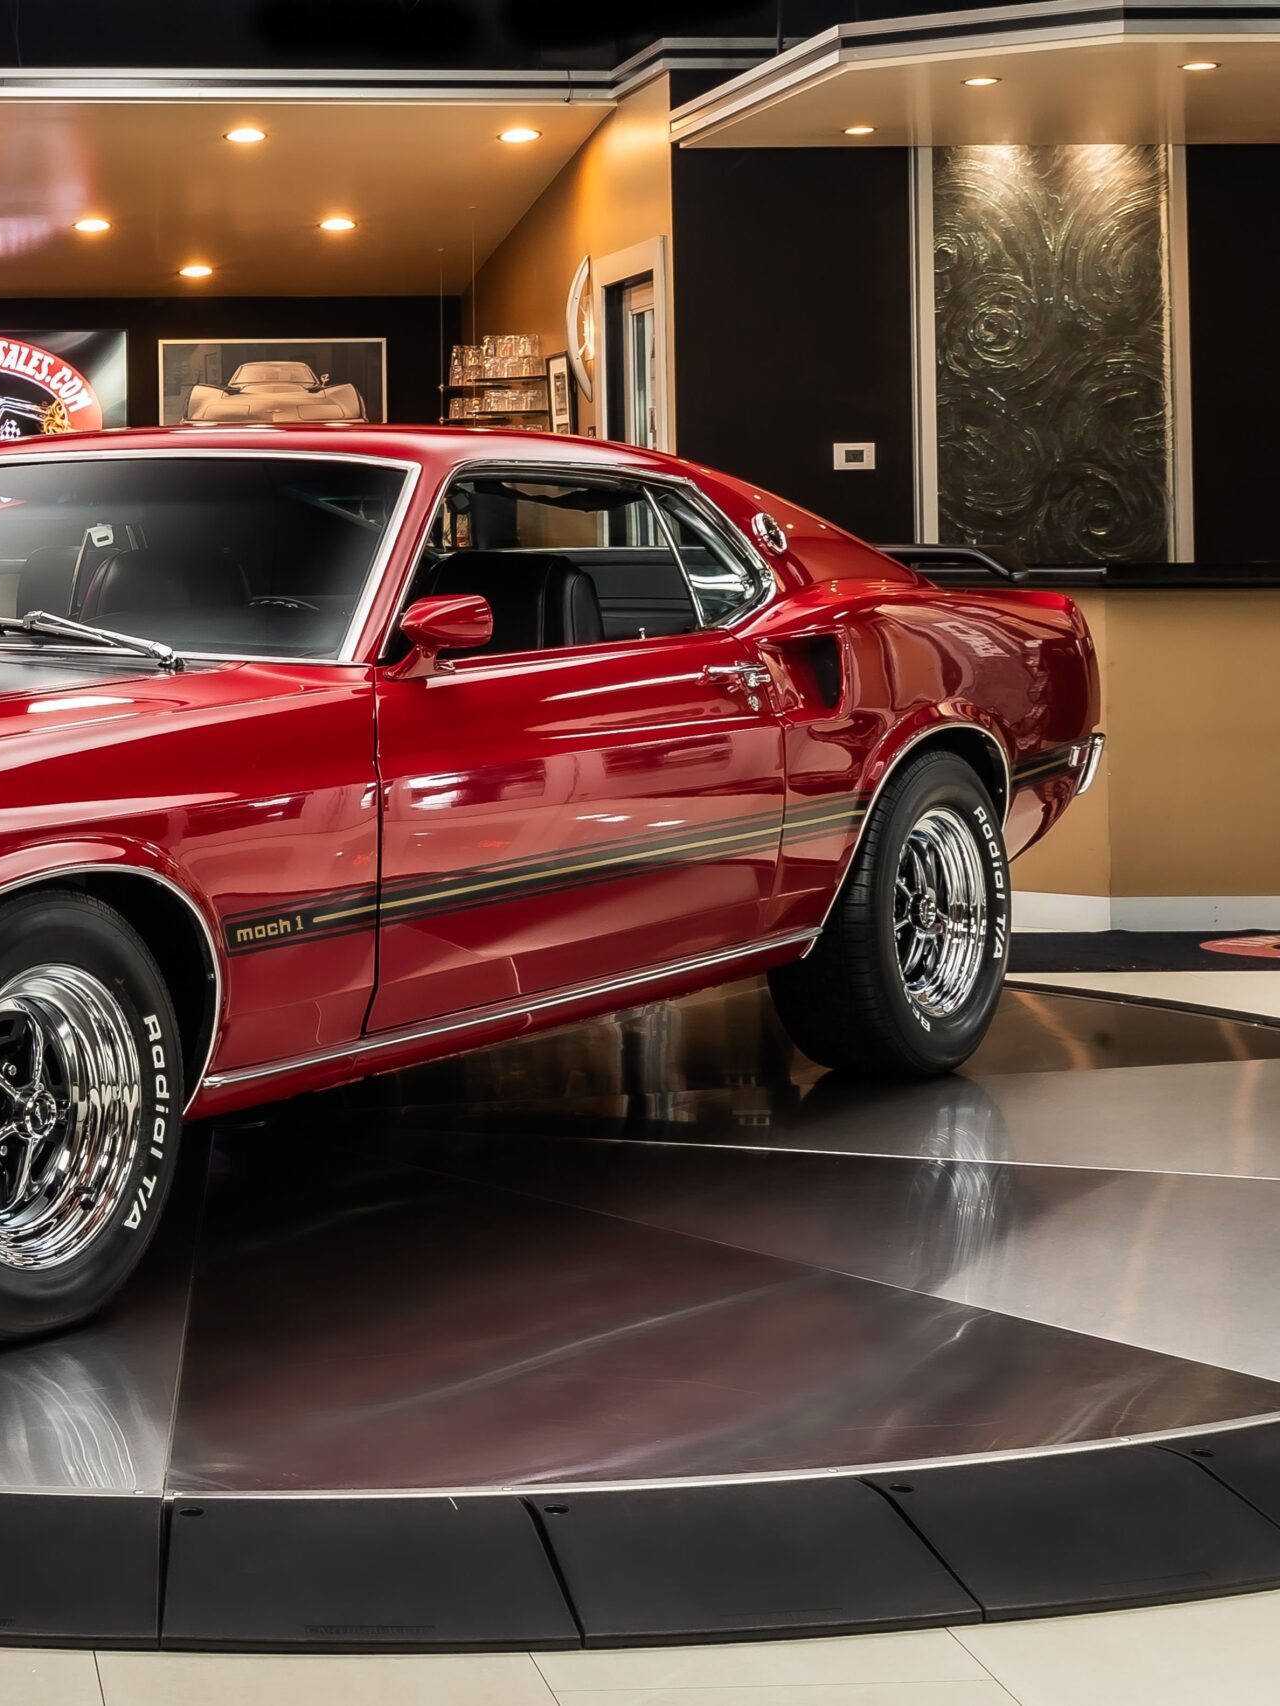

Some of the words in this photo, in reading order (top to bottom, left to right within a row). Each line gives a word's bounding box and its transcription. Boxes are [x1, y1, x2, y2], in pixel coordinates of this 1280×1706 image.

[236, 918, 291, 942] mach
[295, 915, 304, 930] 1
[973, 806, 1006, 900] Radial
[993, 914, 1006, 959] T/A
[143, 1014, 170, 1159] Radial
[123, 1175, 157, 1230] T/A
